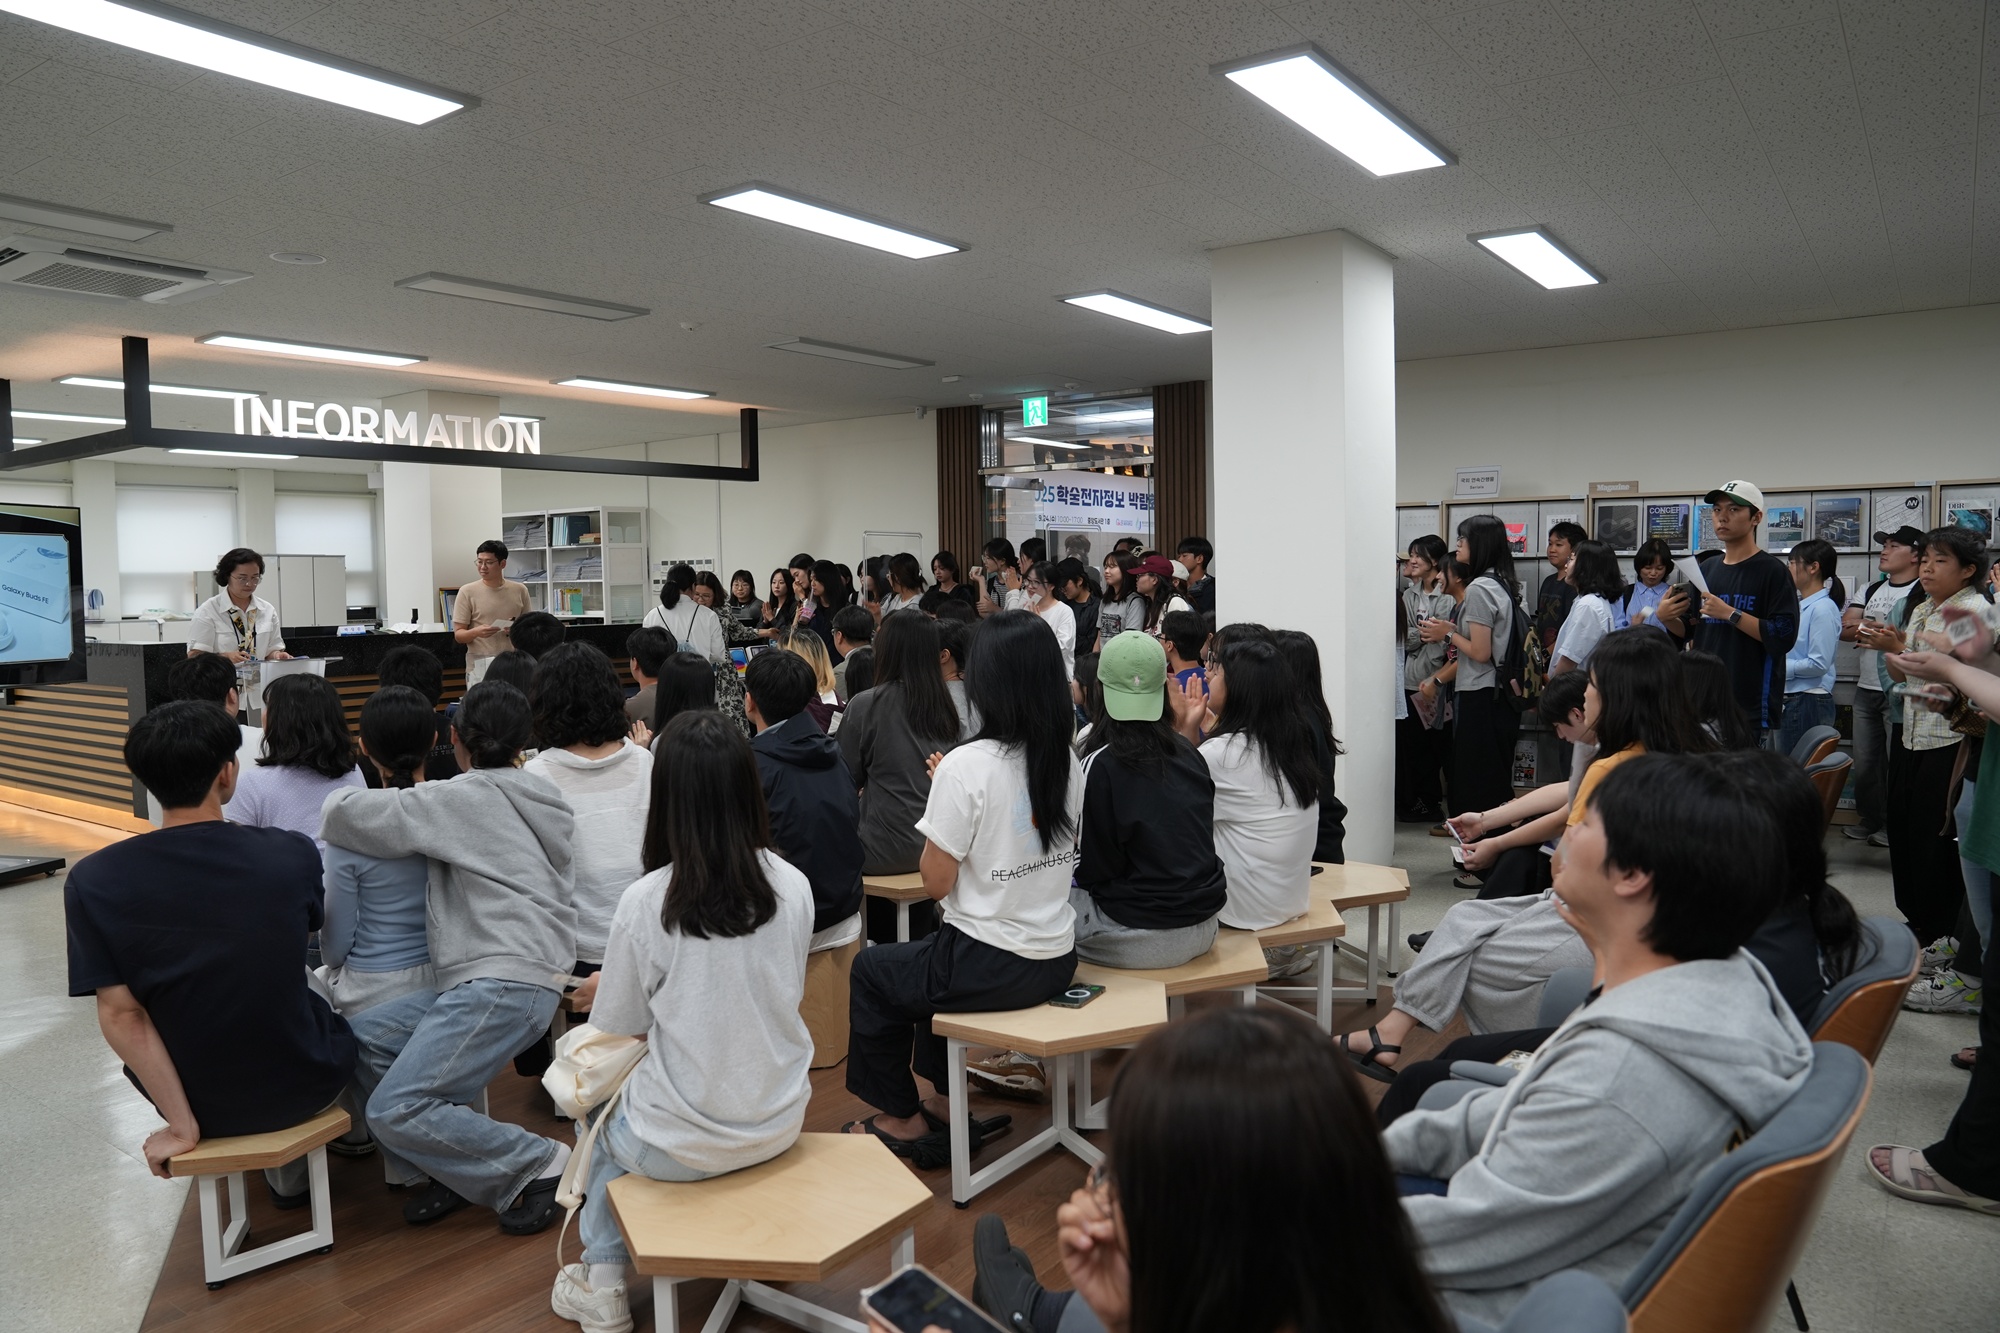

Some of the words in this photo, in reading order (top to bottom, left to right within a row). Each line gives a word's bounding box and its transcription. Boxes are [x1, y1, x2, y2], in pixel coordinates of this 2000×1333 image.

[232, 391, 541, 455] INFORMATION
[1596, 484, 1630, 492] Magazine
[1724, 483, 1738, 492] H
[1057, 485, 1125, 508] 학술전자정보
[1649, 506, 1687, 514] CONCEPT
[2, 584, 26, 597] Galaxy
[25, 591, 42, 601] Buds
[1733, 594, 1756, 611] THE
